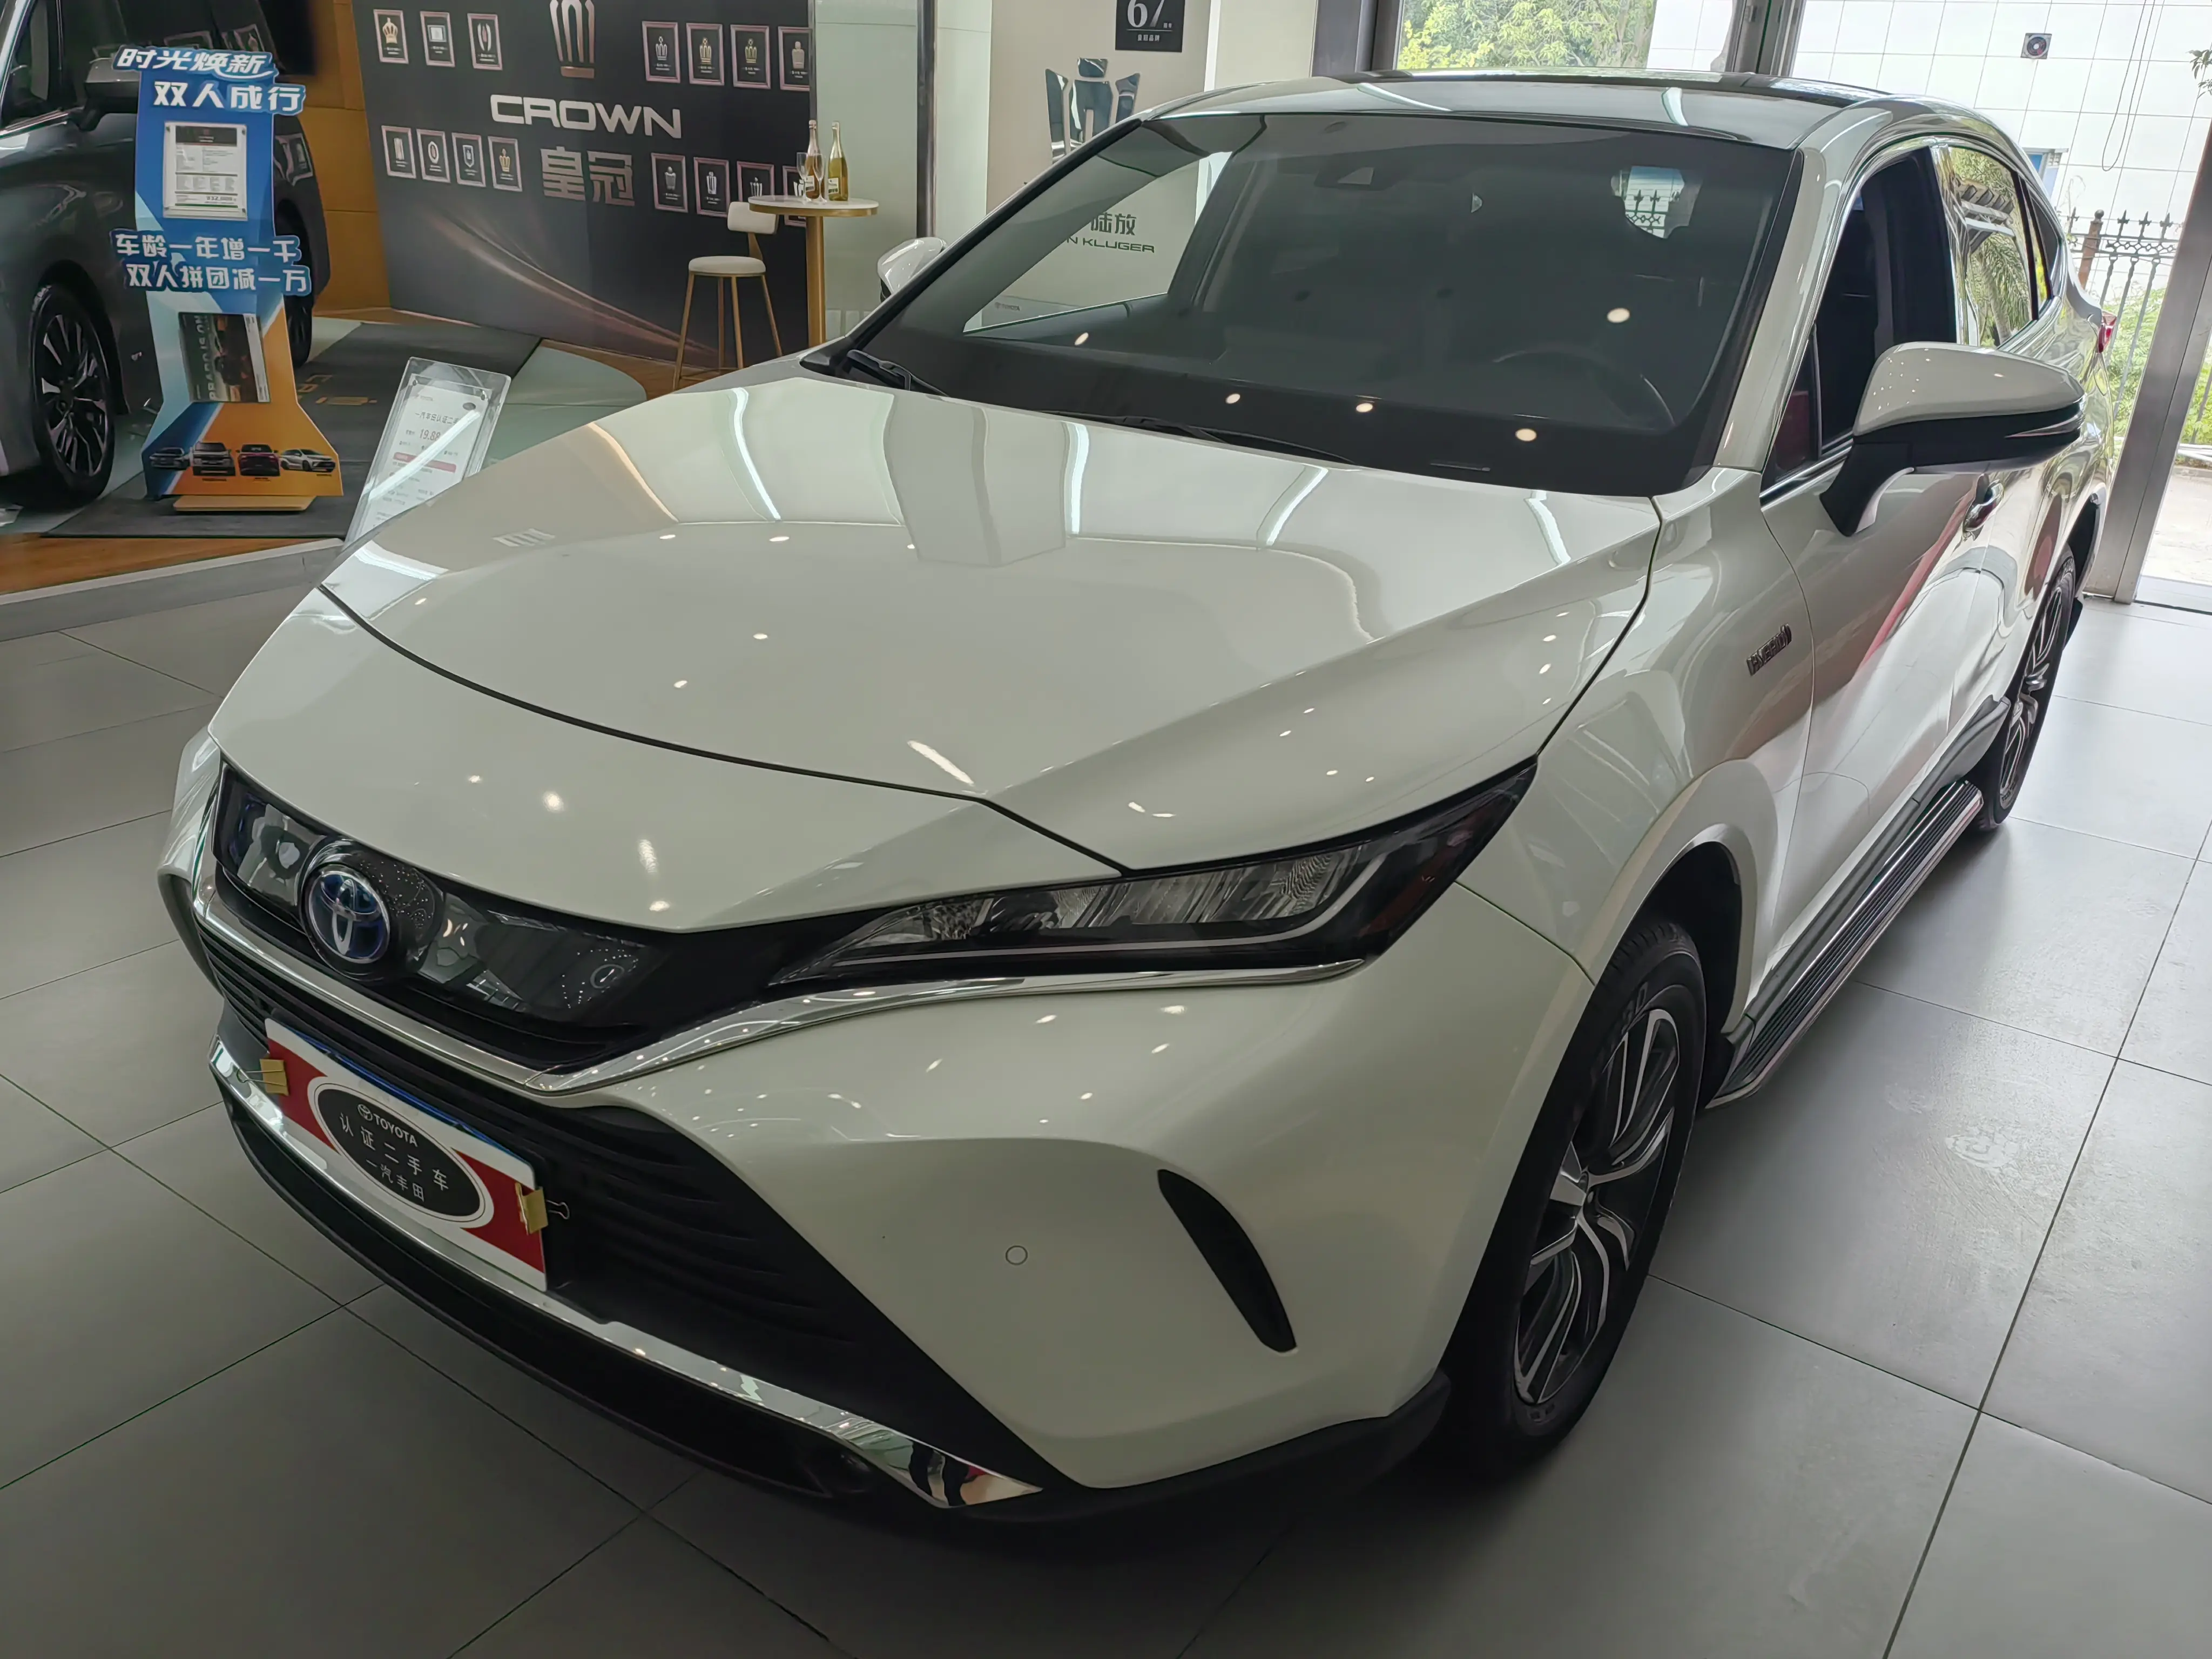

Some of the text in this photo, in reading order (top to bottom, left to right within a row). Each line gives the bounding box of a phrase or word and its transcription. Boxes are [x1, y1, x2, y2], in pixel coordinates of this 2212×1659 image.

[117, 48, 273, 79] 时光焕新
[153, 81, 302, 112] 双人成行
[490, 94, 682, 139] CROWN
[540, 146, 635, 206] 皇冠
[1090, 212, 1136, 235] 陆放
[116, 233, 301, 262] 车龄一年增一千
[1083, 238, 1155, 253] KLUGER
[126, 264, 308, 292] 双人拼团减一万
[373, 1114, 419, 1147] TOYOTA
[339, 1113, 449, 1191] 认证二手车
[366, 1159, 426, 1202] 一汽丰田
